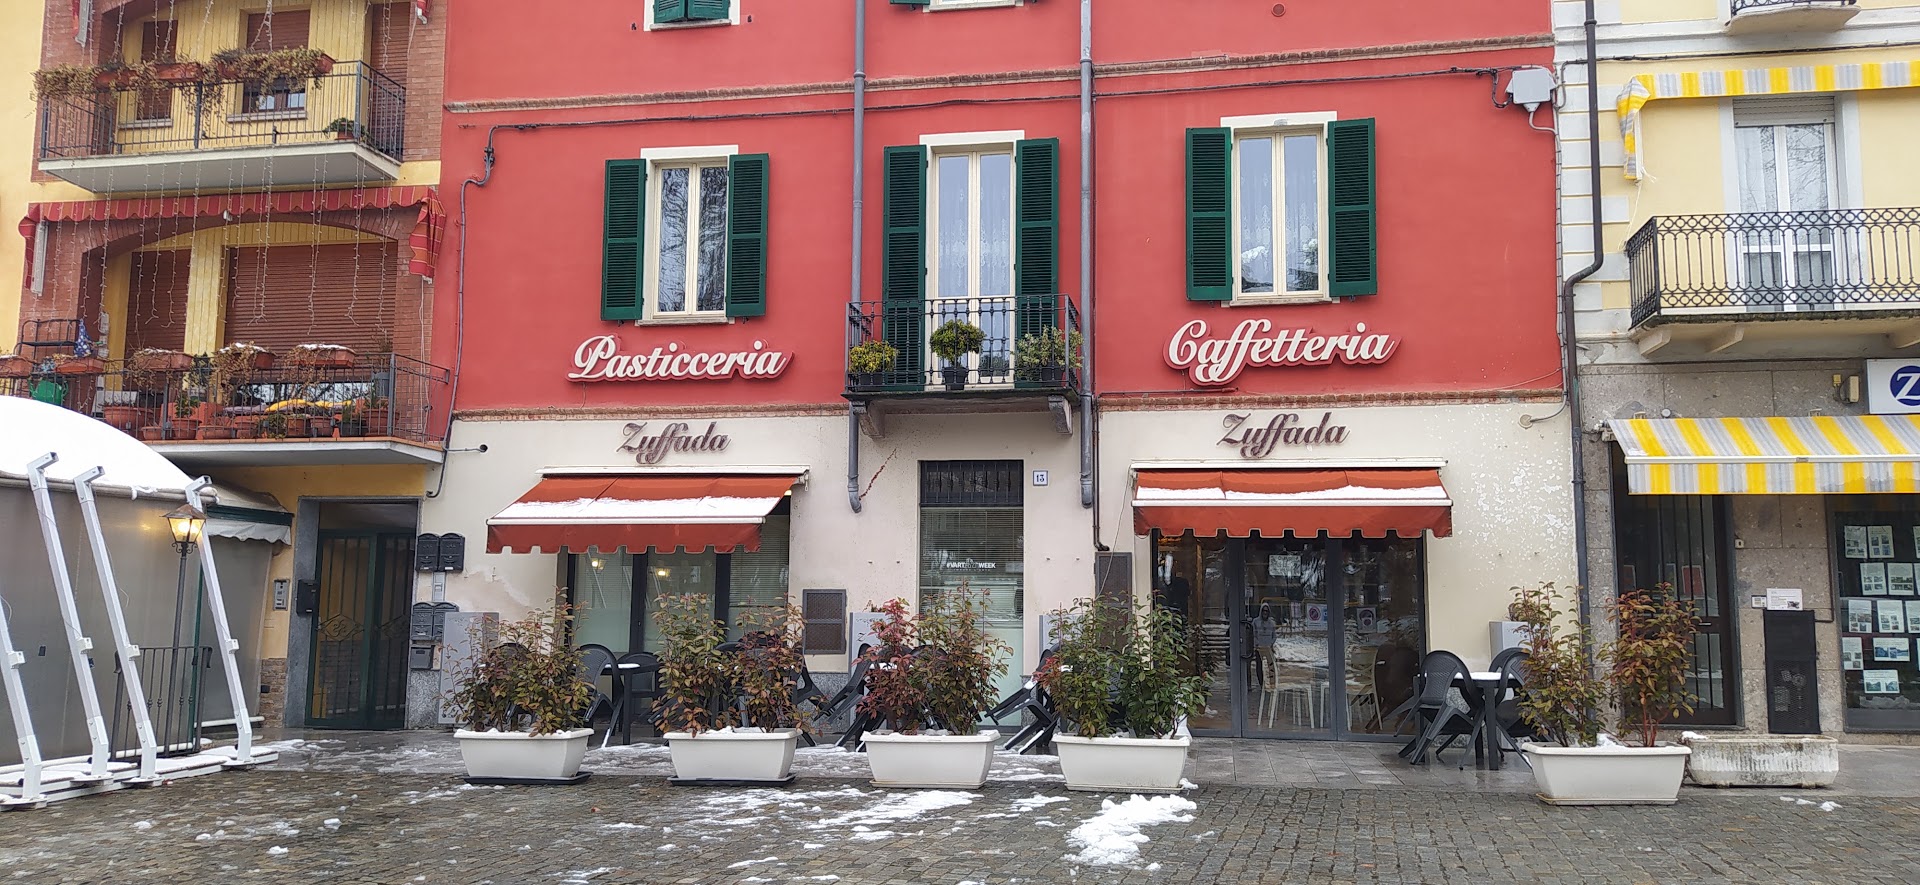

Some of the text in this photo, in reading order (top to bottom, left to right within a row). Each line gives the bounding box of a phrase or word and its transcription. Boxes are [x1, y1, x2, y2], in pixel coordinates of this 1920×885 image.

[567, 333, 791, 379] Pasticceria
[1168, 318, 1396, 383] Caffetteria
[616, 421, 732, 465] Zuffada
[1216, 411, 1351, 459] Zuffada
[1036, 474, 1045, 483] 13
